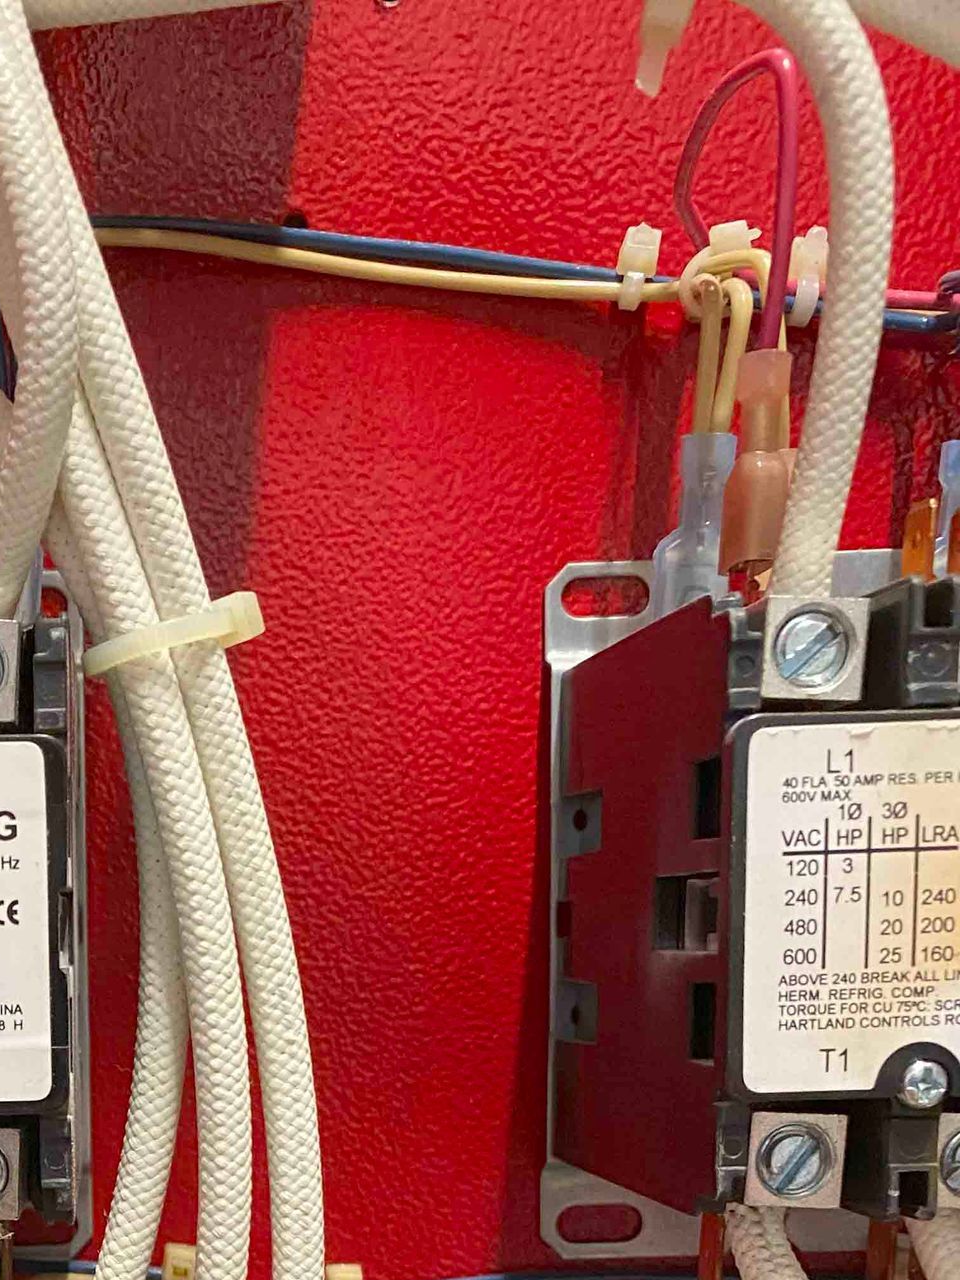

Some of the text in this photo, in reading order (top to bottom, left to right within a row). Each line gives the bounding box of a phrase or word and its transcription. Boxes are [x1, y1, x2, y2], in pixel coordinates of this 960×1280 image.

[827, 748, 854, 774] L1
[781, 826, 959, 847] VAC HP HP LRA
[1, 856, 20, 871] Hz
[786, 858, 853, 876] 120 3
[784, 886, 957, 907] 240 7.5 10 240
[784, 917, 955, 936] 480 20 200
[783, 946, 954, 965] 600 25 160
[14, 1020, 23, 1031] H
[819, 1048, 849, 1073] T1
